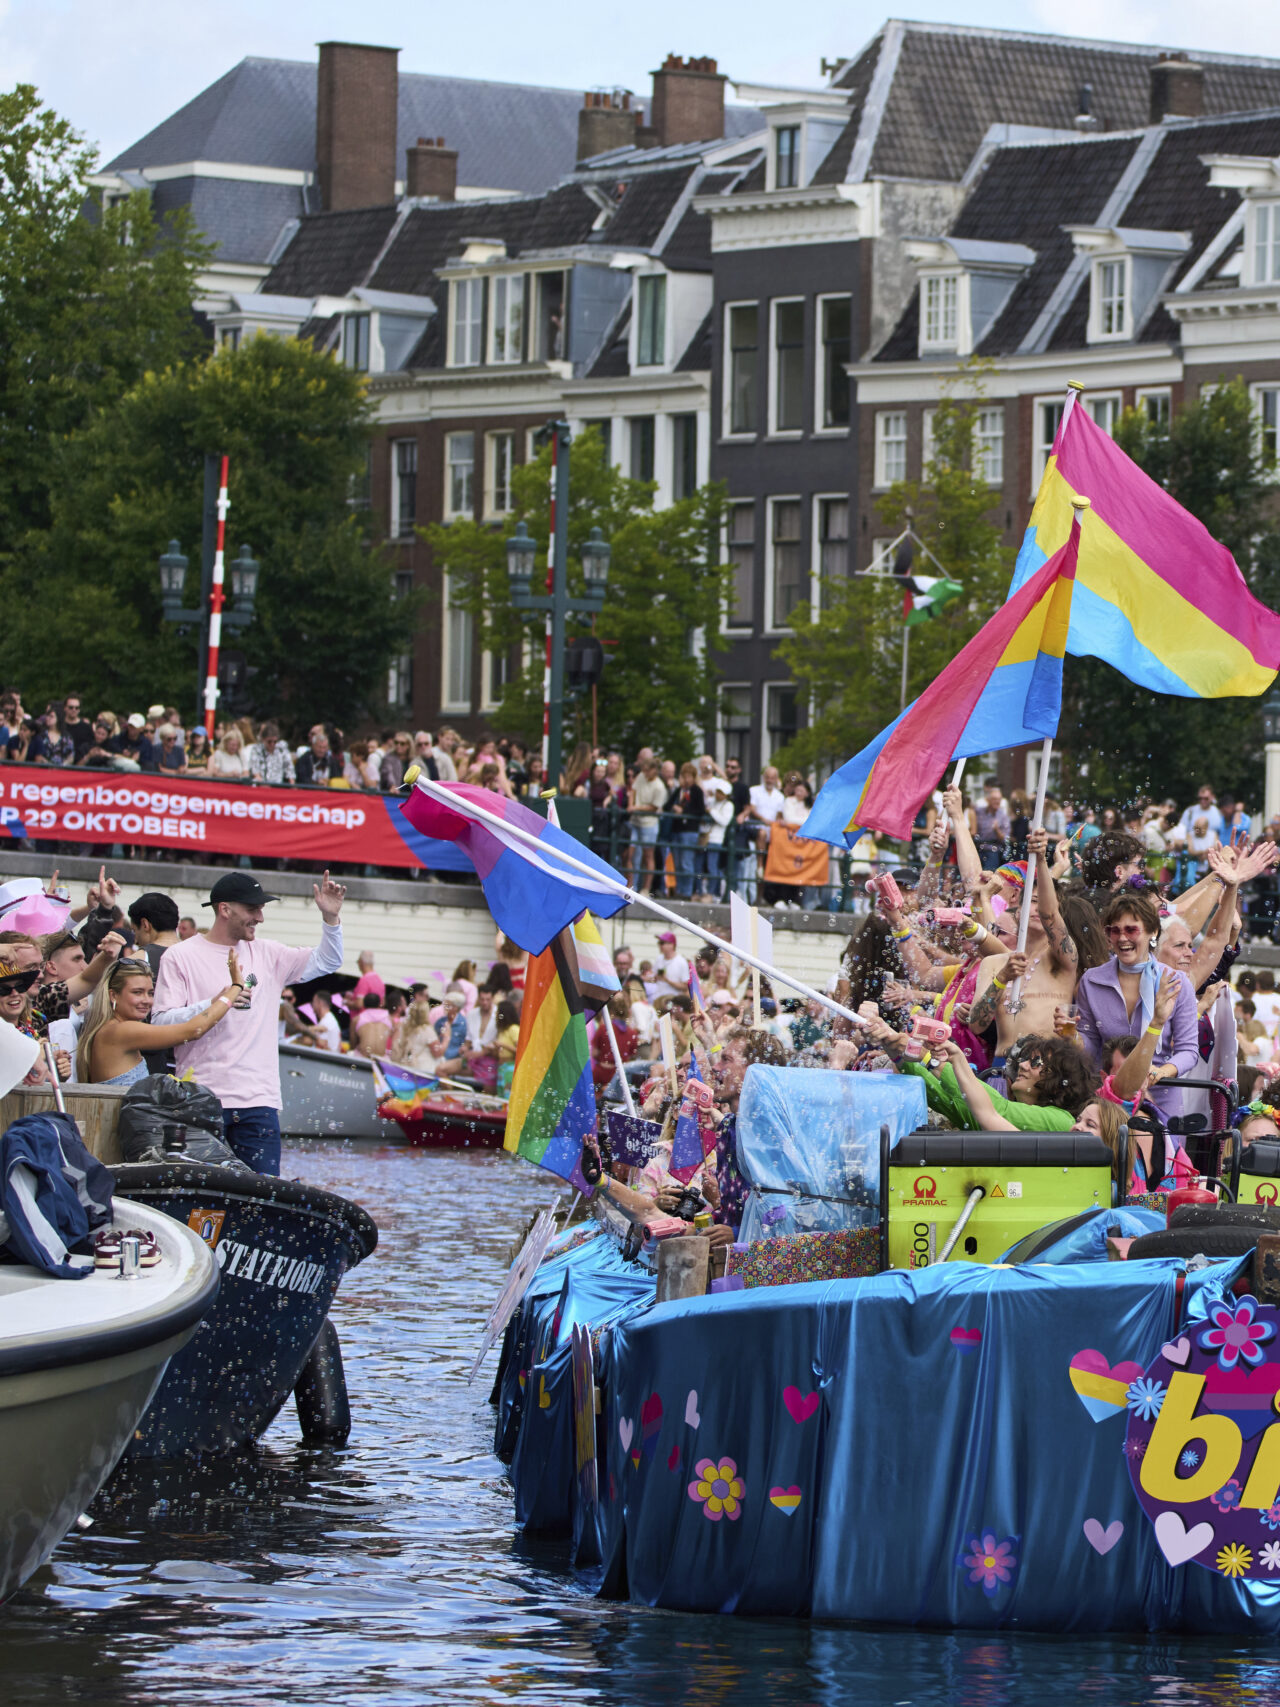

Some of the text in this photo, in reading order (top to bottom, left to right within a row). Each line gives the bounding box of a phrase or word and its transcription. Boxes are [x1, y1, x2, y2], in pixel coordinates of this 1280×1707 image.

[11, 783, 365, 829] regenbooggemeenschap
[25, 809, 57, 828] 29
[62, 811, 206, 840] OKTOBER!
[215, 1239, 326, 1295] STATFJORD
